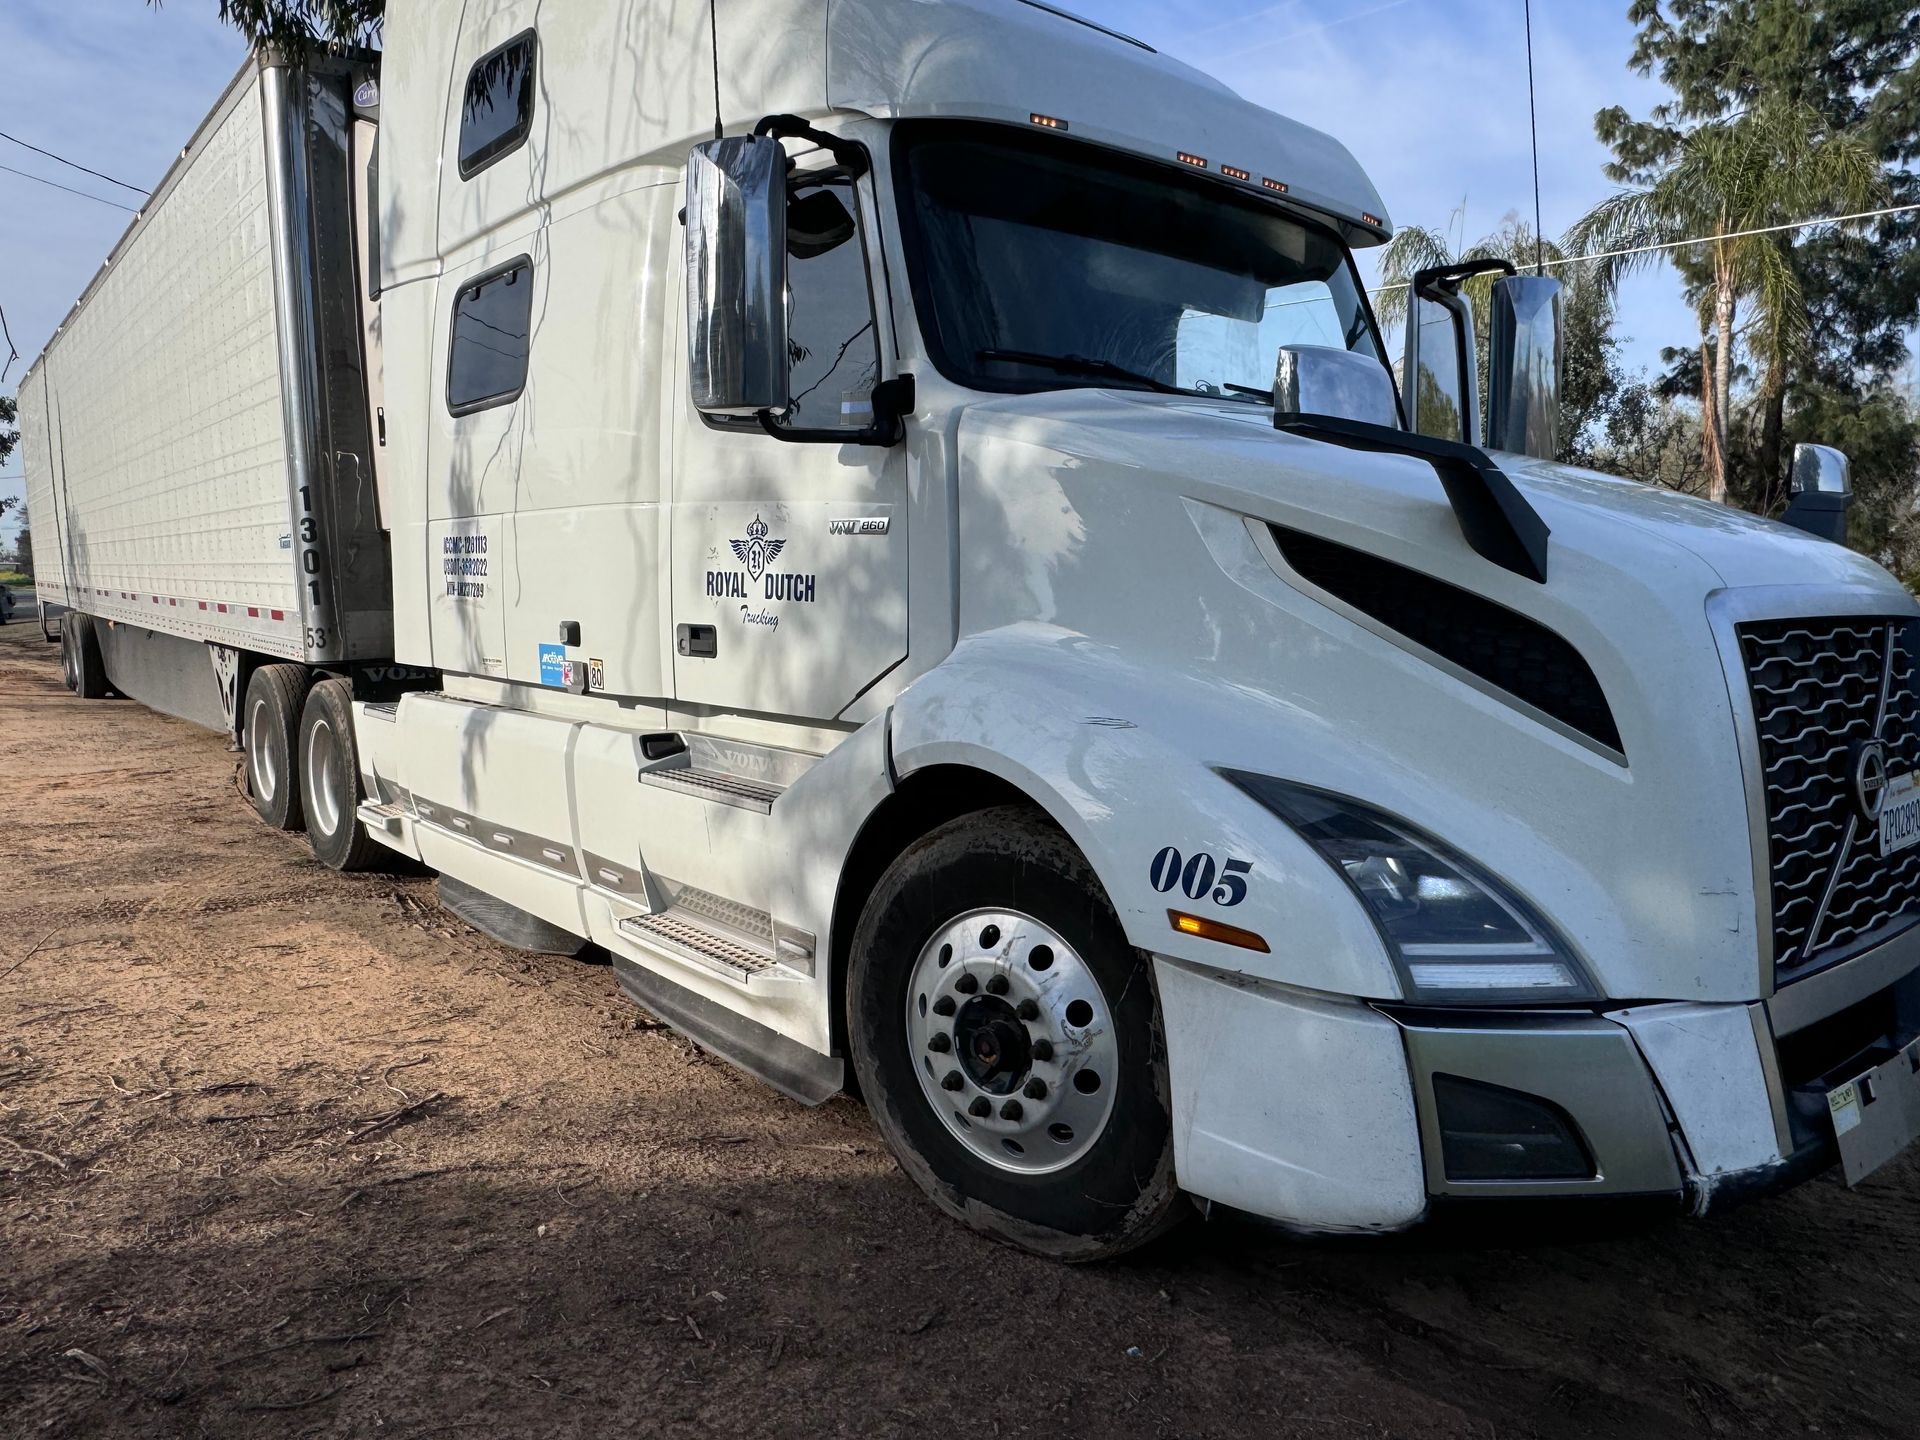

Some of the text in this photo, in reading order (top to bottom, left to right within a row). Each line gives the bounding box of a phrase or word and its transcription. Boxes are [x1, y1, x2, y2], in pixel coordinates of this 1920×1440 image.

[358, 89, 377, 101] Carr
[862, 520, 886, 530] 860
[299, 486, 321, 606] 1301
[706, 571, 816, 602] ROYAL DUTCH
[740, 604, 779, 632] Trucking
[591, 667, 602, 686] 80
[1149, 846, 1254, 907] 005
